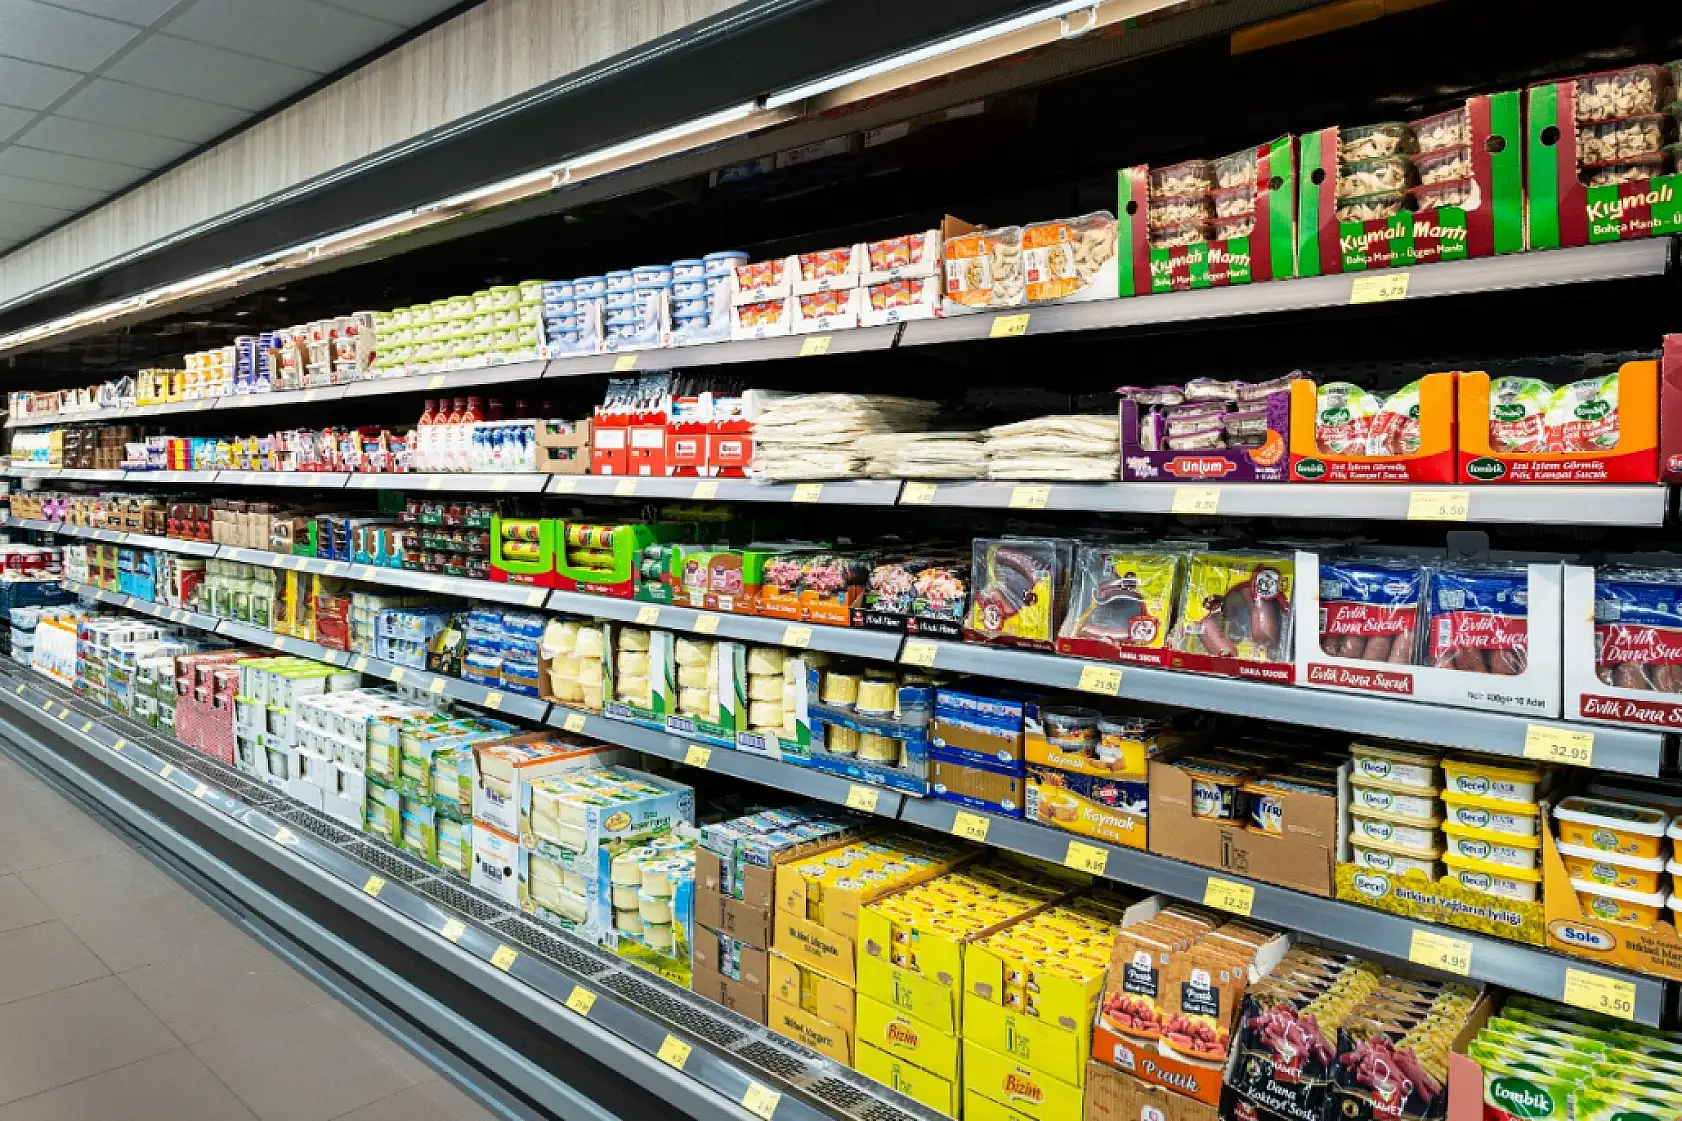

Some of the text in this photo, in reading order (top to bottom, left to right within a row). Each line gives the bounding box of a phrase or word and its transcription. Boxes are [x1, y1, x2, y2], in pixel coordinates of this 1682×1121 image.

[1586, 184, 1673, 222] Kıymalı
[1340, 221, 1467, 254] Kıymalı Mantı
[1149, 248, 1250, 276] Kıymalı Mantı
[1491, 629, 1527, 645] Sucu
[1651, 643, 1682, 659] Suc
[1583, 697, 1682, 723] Evlik Dana S
[1550, 744, 1588, 760] 32.95
[1083, 806, 1135, 829] Kaymak
[1395, 888, 1436, 905] Bitkisel
[1440, 898, 1485, 917] Yağların
[1564, 926, 1601, 945] Sole
[1439, 953, 1467, 969] 4.95
[1599, 993, 1631, 1012] 3.50
[1005, 1074, 1044, 1101] Bizim
[1266, 1079, 1297, 1100] Dana
[1494, 1083, 1549, 1112] tombik
